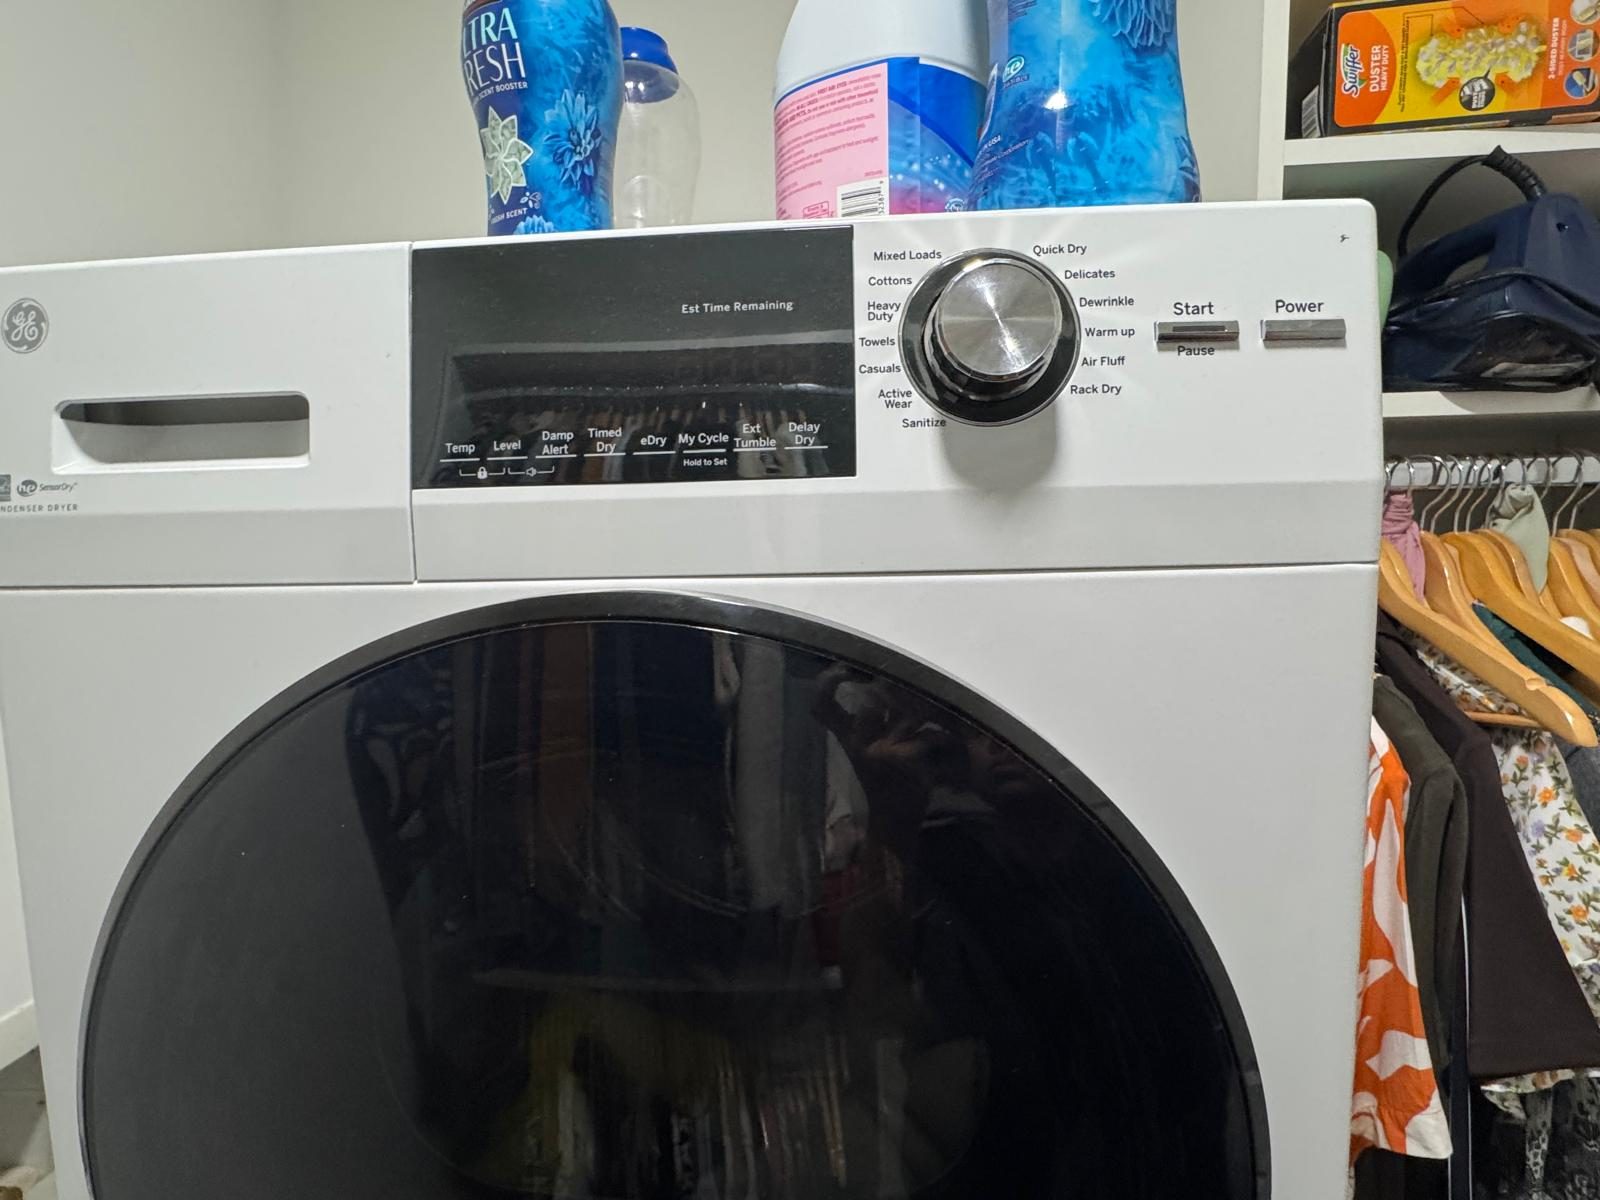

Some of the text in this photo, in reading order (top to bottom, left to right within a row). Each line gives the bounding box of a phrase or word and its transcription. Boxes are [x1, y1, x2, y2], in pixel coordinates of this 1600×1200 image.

[1551, 17, 1560, 47] DUSTER
[1342, 45, 1364, 97] Swiffer
[1369, 44, 1382, 93] DUSTER
[495, 81, 529, 92] BOOSTER
[873, 249, 942, 262] Mixed Loads
[1032, 243, 1087, 256] Quick Dry
[1064, 268, 1116, 280] Delicates
[868, 276, 913, 287] Cottons
[681, 299, 794, 315] Est Time Remaining
[867, 301, 901, 313] Heavy
[1079, 296, 1135, 308] Dewrinkle
[1172, 301, 1215, 315] Start
[1275, 299, 1324, 313] Power
[867, 311, 894, 323] Duty
[1084, 327, 1136, 338] Warm up
[858, 336, 896, 348] Towels
[1177, 345, 1215, 356] Pause
[1081, 356, 1126, 367] Air Fluff
[858, 363, 902, 375] Casuals
[878, 388, 913, 399] Active
[1070, 384, 1122, 396] Rack Dry
[884, 399, 913, 409] Wear
[788, 421, 821, 436] Delay
[902, 417, 947, 428] Sanitize
[587, 427, 622, 439] Timed
[742, 423, 761, 435] Ext
[541, 430, 574, 444] Damp
[639, 435, 667, 449] eDry
[678, 431, 729, 446] My Cycle
[734, 436, 777, 449] Tumble
[794, 433, 816, 448] Dry
[445, 442, 476, 457] Temp
[492, 439, 522, 452] Level
[541, 443, 569, 456] Alert
[596, 441, 617, 455] Dry
[682, 457, 728, 467] Hold to Set
[47, 503, 78, 512] DRYER
